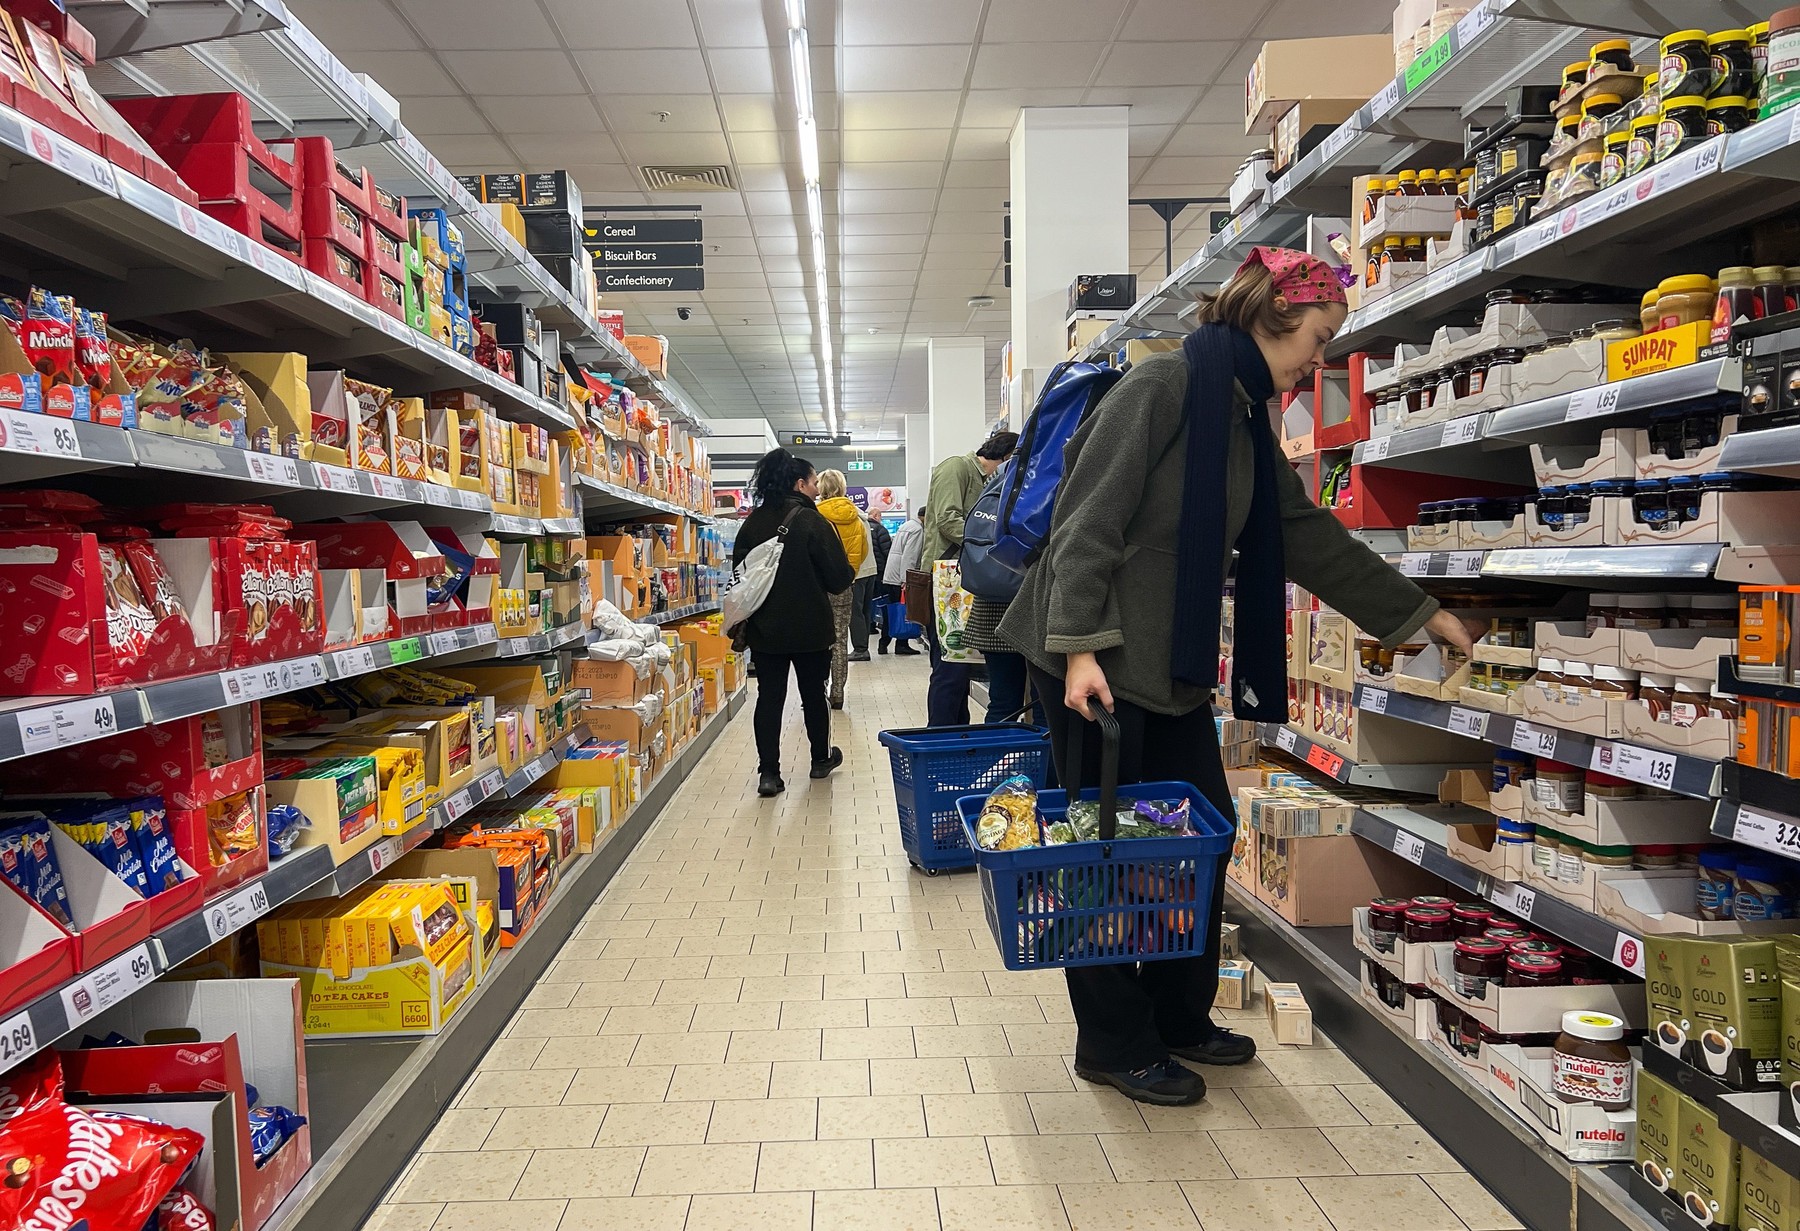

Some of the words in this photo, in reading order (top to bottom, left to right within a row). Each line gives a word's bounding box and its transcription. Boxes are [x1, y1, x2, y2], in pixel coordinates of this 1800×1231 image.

[1434, 41, 1449, 66] 2.99
[1662, 57, 1681, 69] MITE
[1385, 84, 1398, 104] 1.49
[1660, 123, 1678, 136] MITE
[1694, 147, 1717, 171] 1.99
[603, 225, 636, 238] Cereal
[604, 250, 635, 262] Biscuit
[636, 250, 657, 261] Bars
[606, 274, 673, 288] Confectionery
[1649, 363, 1667, 372] BUTTER
[1756, 366, 1774, 374] ESPRESSO
[1597, 388, 1618, 409] 1.65
[1462, 421, 1476, 437] 1.65
[54, 427, 76, 451] 85p
[804, 437, 819, 445] Ready
[283, 464, 298, 481] 1.29
[345, 474, 358, 490] 1.85
[1417, 558, 1428, 571] 1.15
[1466, 557, 1480, 571] 1.89
[263, 671, 277, 689] 1.75
[1375, 695, 1387, 709] 1.65
[95, 706, 114, 728] 49p
[1469, 716, 1482, 732] 1.09
[1538, 733, 1555, 751] 1.29
[1650, 759, 1672, 782] 1.35
[1740, 811, 1749, 819] Gold
[1738, 819, 1752, 828] Ground
[1752, 823, 1765, 831] Coffee
[153, 836, 170, 858] Milk
[1411, 843, 1424, 859] 1.65
[117, 850, 133, 873] Milk
[150, 847, 177, 874] Chocolate
[38, 862, 52, 885] Milk
[116, 860, 143, 881] Chocolate
[36, 872, 62, 904] Chocolate
[250, 891, 266, 912] 1.09
[1516, 892, 1533, 913] 1.65
[131, 955, 150, 979] 95p
[339, 983, 374, 991] CHOCOLATE
[1651, 981, 1682, 1000] GOLD
[310, 993, 321, 1002] 10
[323, 993, 348, 1001] TEA
[351, 991, 389, 1001] CAKES
[1692, 987, 1726, 1006] GOLD
[408, 1004, 422, 1013] TC
[309, 1016, 320, 1024] 23
[404, 1014, 428, 1024] 6600
[1, 1024, 31, 1060] 2.69
[1566, 1060, 1605, 1076] nutella
[1490, 1063, 1516, 1092] nutella
[1575, 1128, 1626, 1143] nutella
[1640, 1118, 1669, 1147] GOLD
[1682, 1147, 1714, 1179] GOLD
[1745, 1182, 1781, 1215] GOLD
